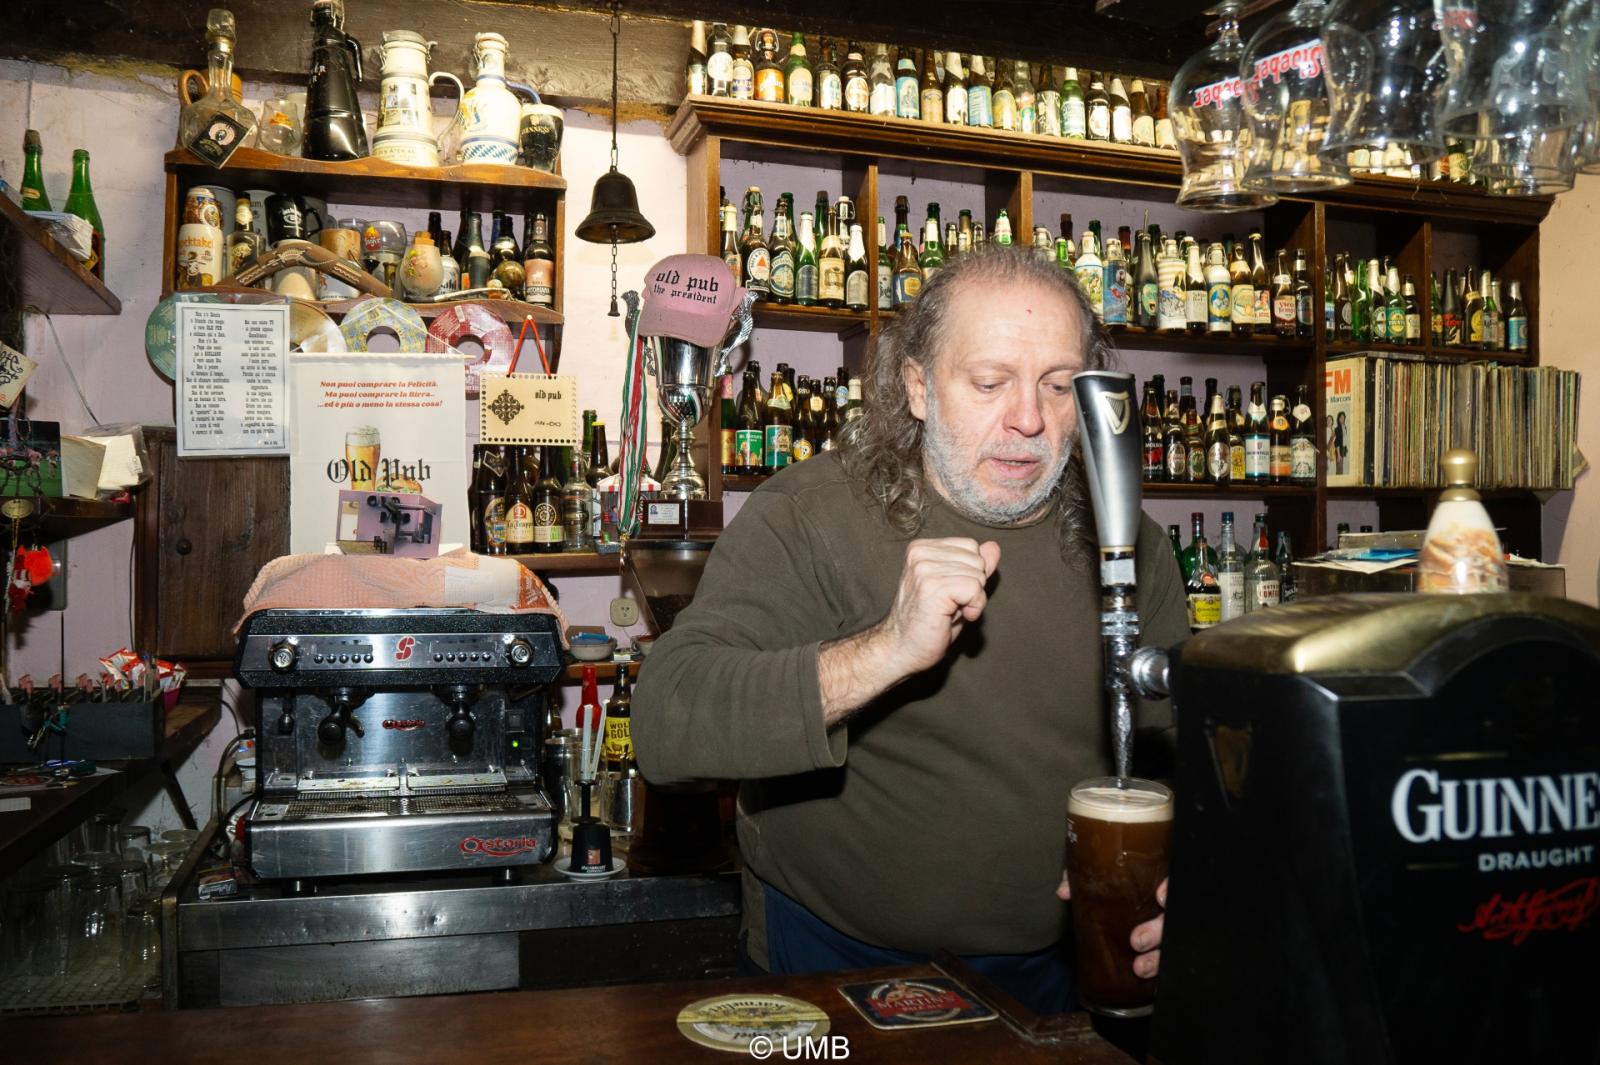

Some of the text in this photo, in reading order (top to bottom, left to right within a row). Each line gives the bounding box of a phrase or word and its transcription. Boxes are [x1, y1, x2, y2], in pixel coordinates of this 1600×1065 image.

[656, 270, 718, 292] old pub
[654, 284, 717, 304] the president
[535, 390, 562, 402] old pub
[327, 458, 431, 488] Old Pub
[610, 729, 630, 739] GOL
[1391, 768, 1600, 843] GUINNE
[1478, 846, 1594, 872] DRAUGHT
